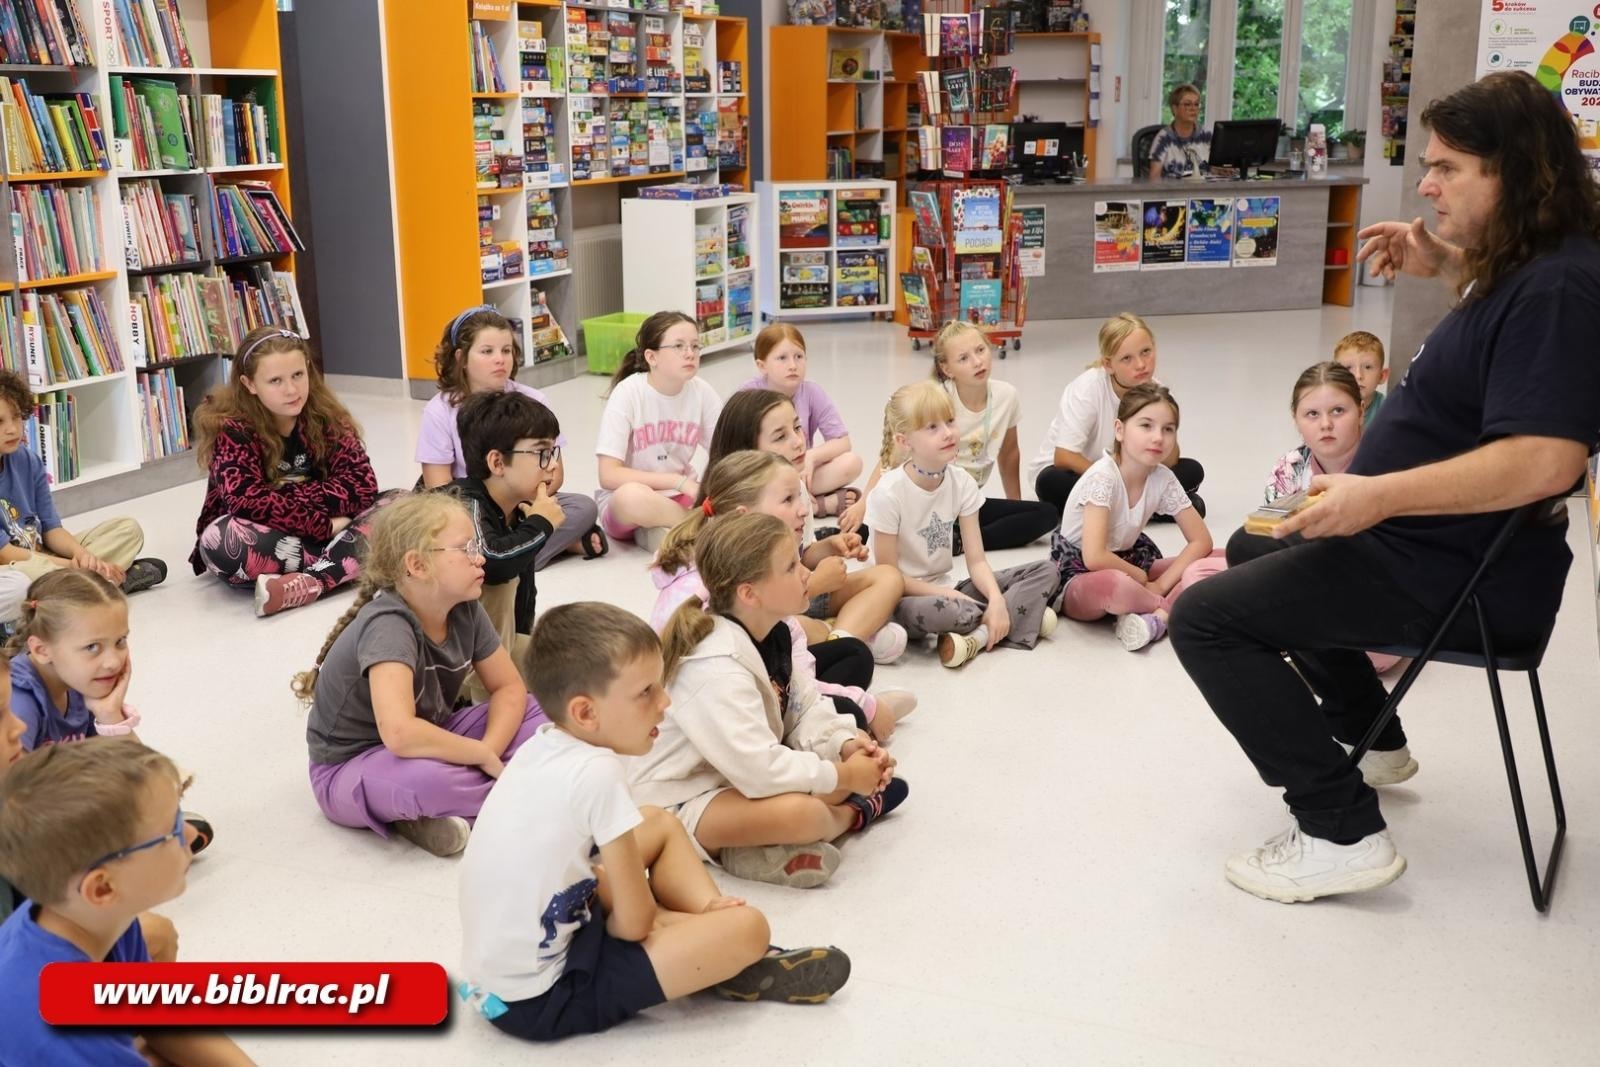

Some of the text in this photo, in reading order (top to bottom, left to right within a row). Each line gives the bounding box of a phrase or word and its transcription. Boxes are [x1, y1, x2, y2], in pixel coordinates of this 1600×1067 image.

[103, 2, 113, 40] SPORT
[1492, 0, 1504, 11] 5
[1579, 79, 1600, 87] BUD
[130, 305, 140, 345] HOBBY
[28, 326, 36, 366] RYSUNEK
